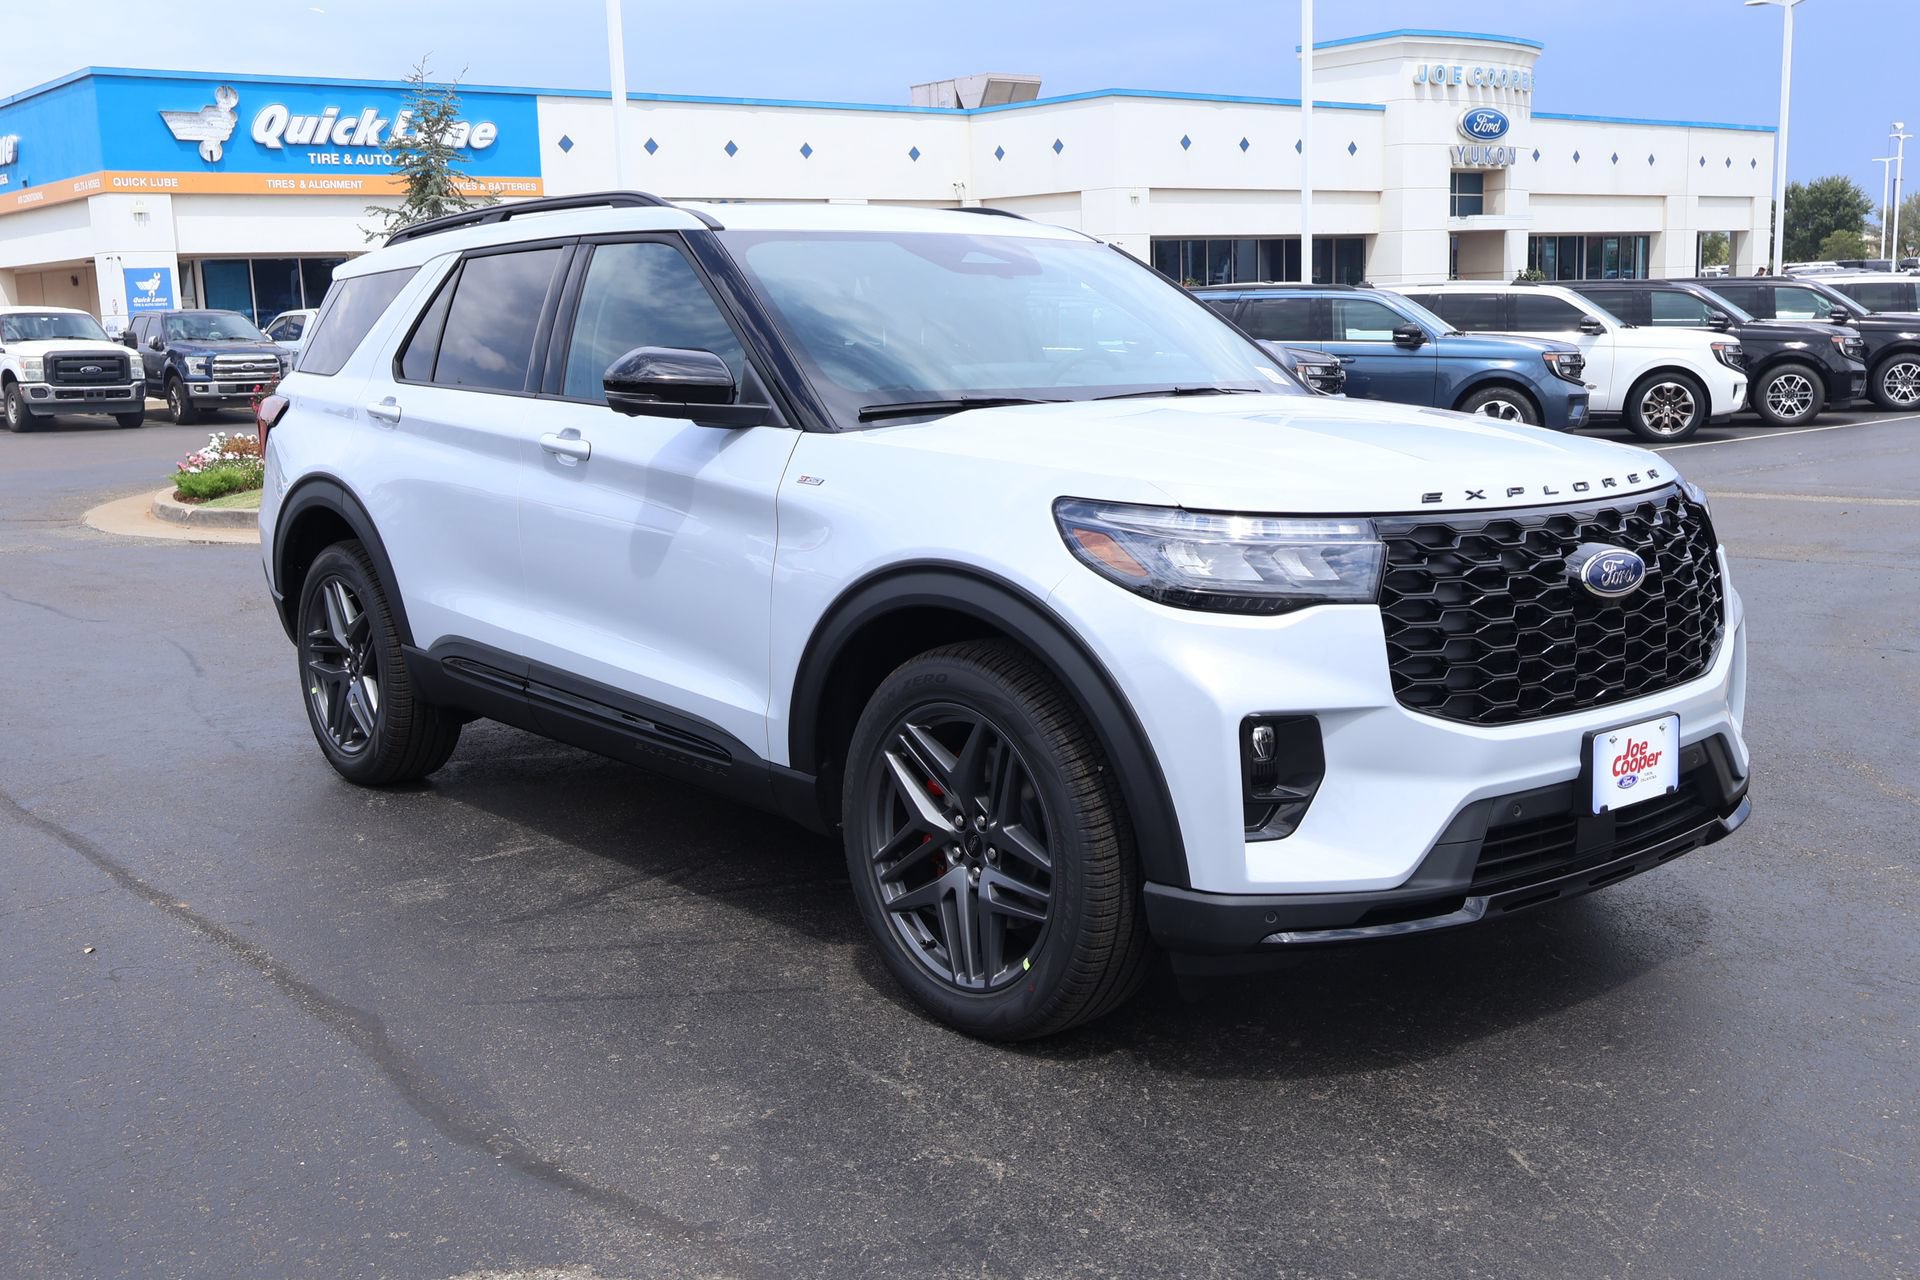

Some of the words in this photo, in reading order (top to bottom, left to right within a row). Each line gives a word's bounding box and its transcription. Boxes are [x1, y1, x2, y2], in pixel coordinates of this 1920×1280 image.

[1415, 64, 1463, 85] JOE
[251, 103, 387, 149] Quick
[1473, 113, 1501, 134] Ford
[307, 152, 340, 165] TIRE
[343, 153, 353, 165] &
[355, 154, 393, 166] AUTO
[1454, 145, 1517, 166] YUKON
[112, 177, 148, 187] QUICK
[150, 178, 179, 187] LUBE
[265, 179, 296, 189] TIRES
[299, 180, 307, 189] &
[308, 180, 364, 190] ALIGNMENT
[480, 182, 487, 191] &
[488, 182, 537, 191] BATTERIES
[1421, 468, 1660, 504] EXPLORER
[1601, 559, 1636, 587] Ford
[904, 673, 948, 690] ZERO
[1622, 738, 1649, 761] Joe
[1612, 750, 1663, 777] Cooper
